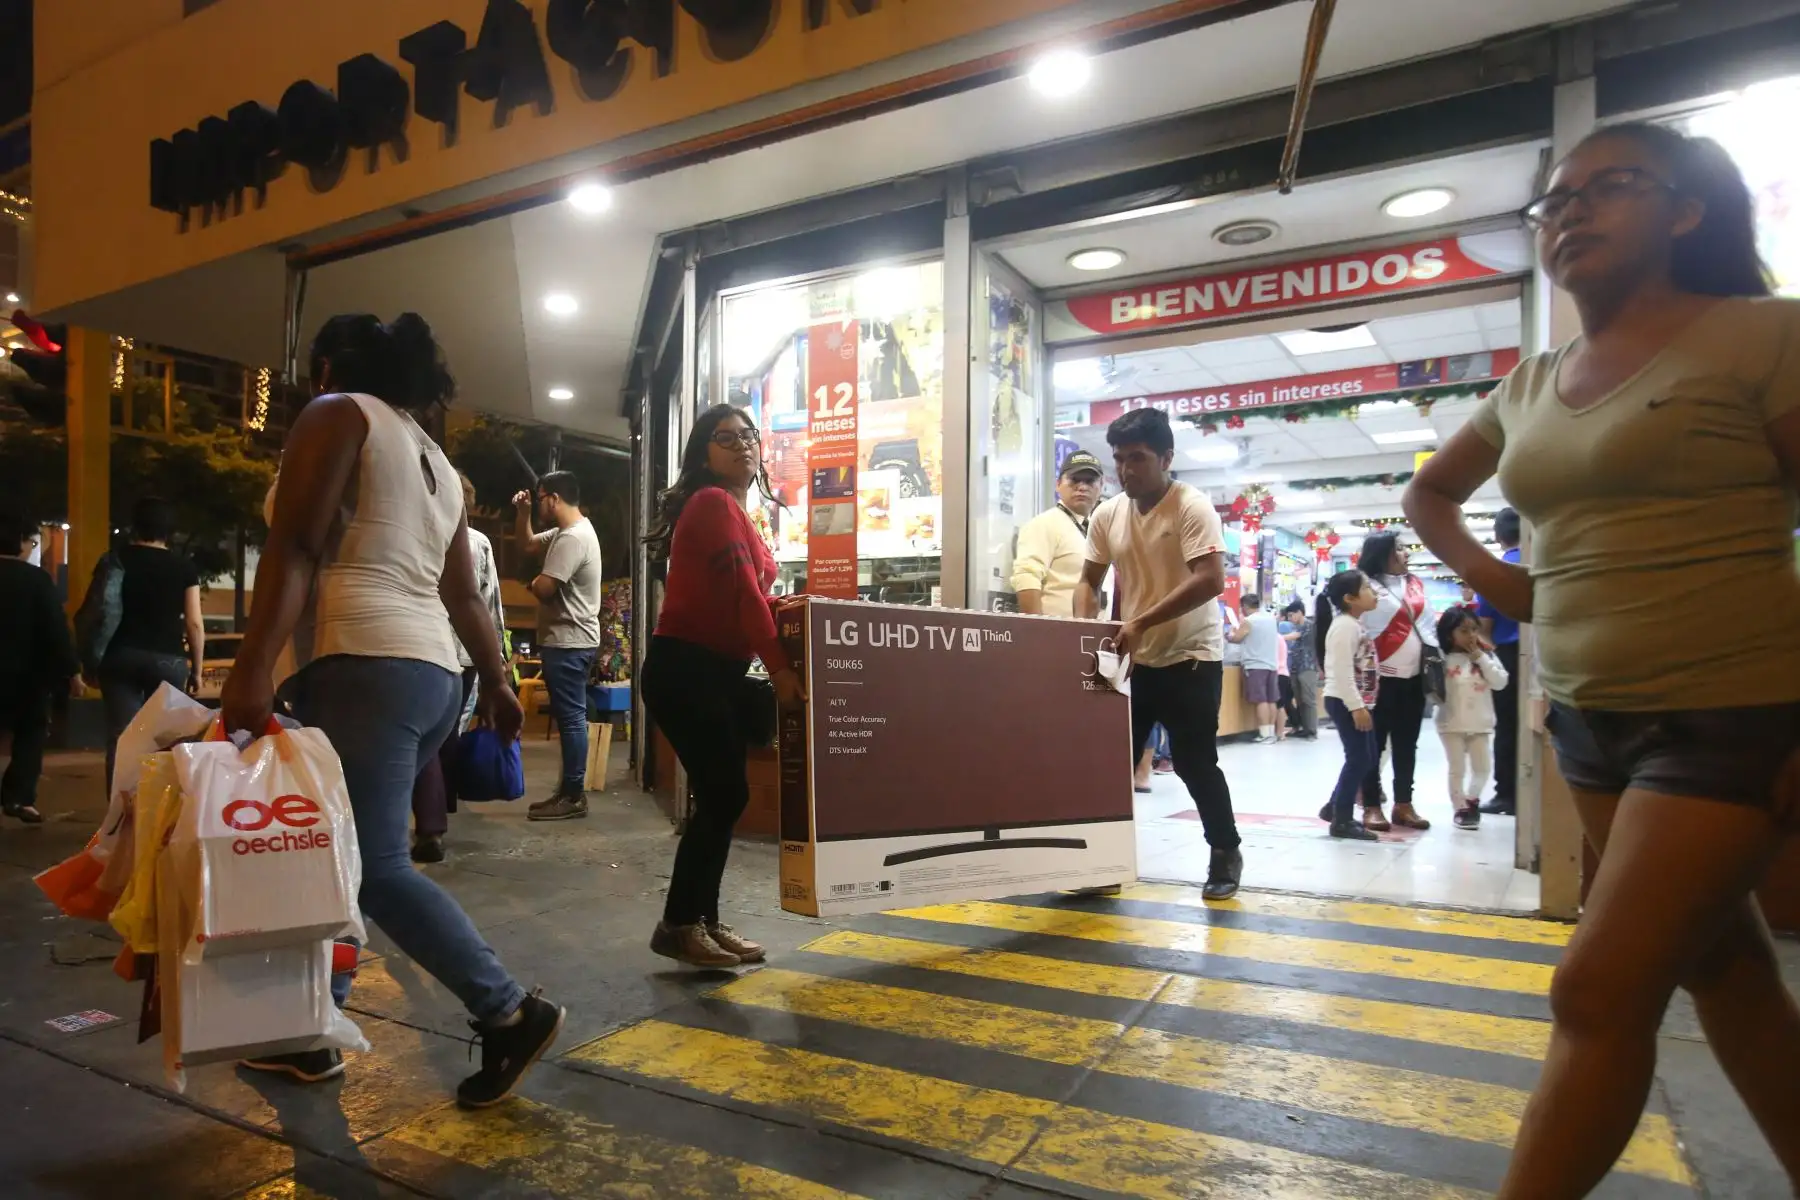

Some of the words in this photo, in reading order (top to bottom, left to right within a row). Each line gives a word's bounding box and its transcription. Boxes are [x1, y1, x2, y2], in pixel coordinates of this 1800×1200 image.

[149, 0, 880, 236] IMPORTACIO
[1110, 247, 1447, 325] BIENVENIDOS
[814, 382, 854, 418] 12
[1152, 391, 1231, 416] meses
[1238, 390, 1263, 407] sin
[1272, 378, 1363, 403] intereses
[811, 417, 856, 433] meses
[823, 433, 856, 441] intereses
[791, 624, 800, 634] LG
[825, 619, 859, 646] LG
[868, 622, 919, 649] UHD
[923, 625, 956, 650] TV
[965, 631, 980, 649] AI
[982, 629, 1013, 643] ThinQ
[826, 658, 863, 670] 50UK65
[1081, 680, 1096, 690] 126
[829, 715, 842, 723] True
[843, 715, 859, 723] Color
[860, 715, 887, 724] Accuracy
[828, 730, 838, 738] 4K
[838, 730, 858, 738] Active
[231, 828, 331, 856] oechsle
